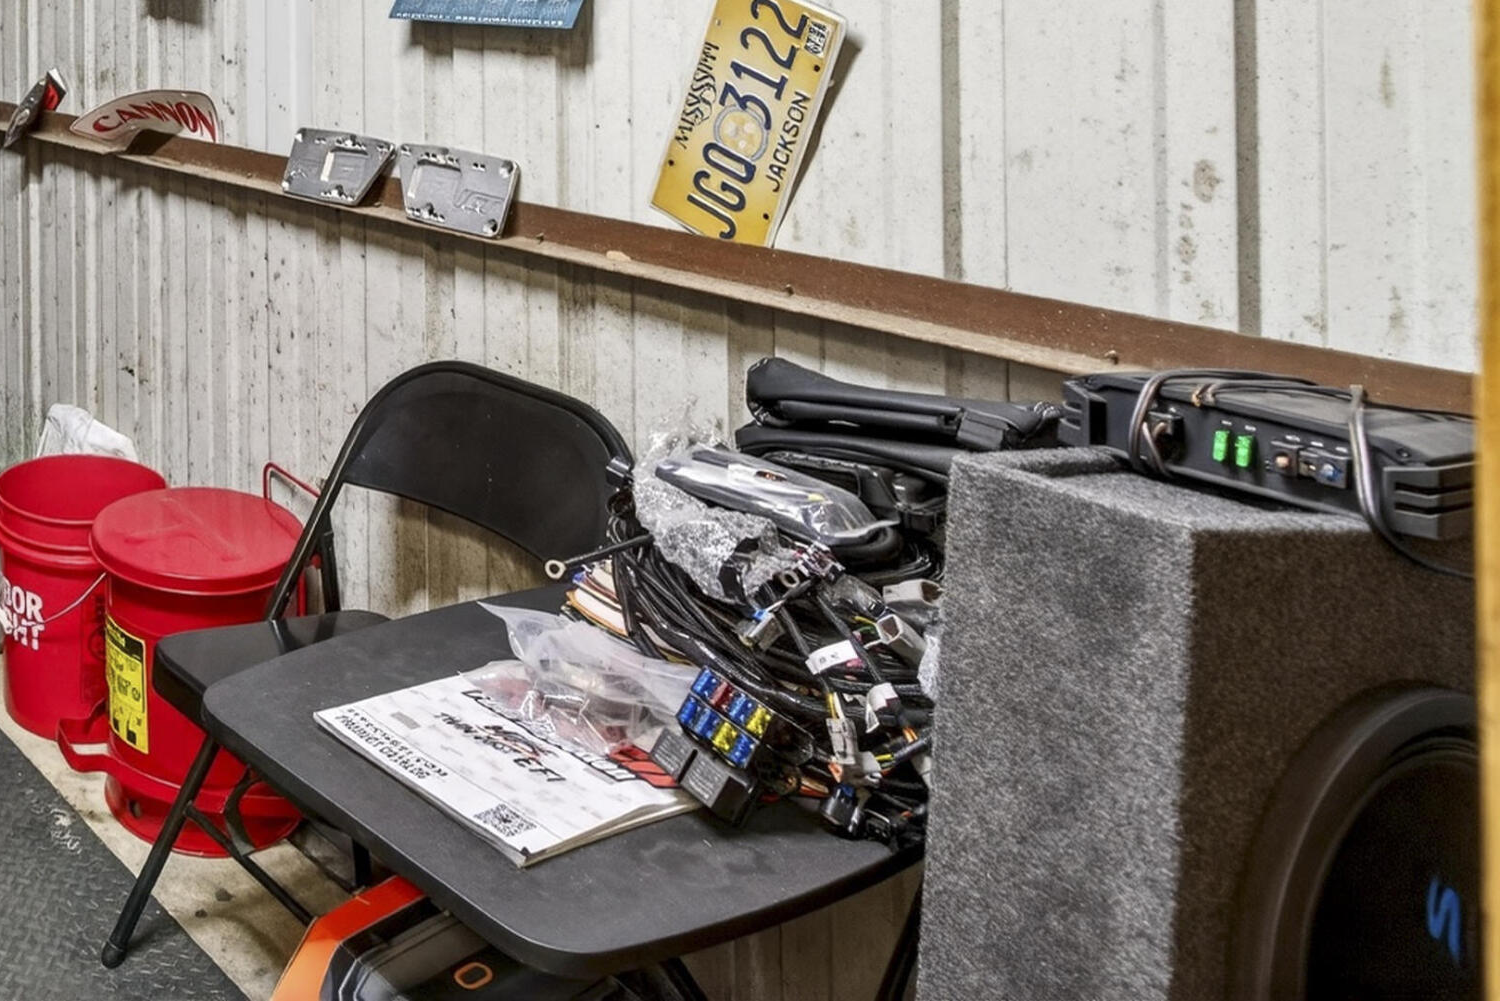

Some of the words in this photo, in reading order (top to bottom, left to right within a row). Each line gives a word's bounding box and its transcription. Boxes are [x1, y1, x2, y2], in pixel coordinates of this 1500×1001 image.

[93, 101, 217, 143] CANNON
[675, 41, 720, 149] MISSISSIPPI
[765, 91, 811, 193] JACKSON
